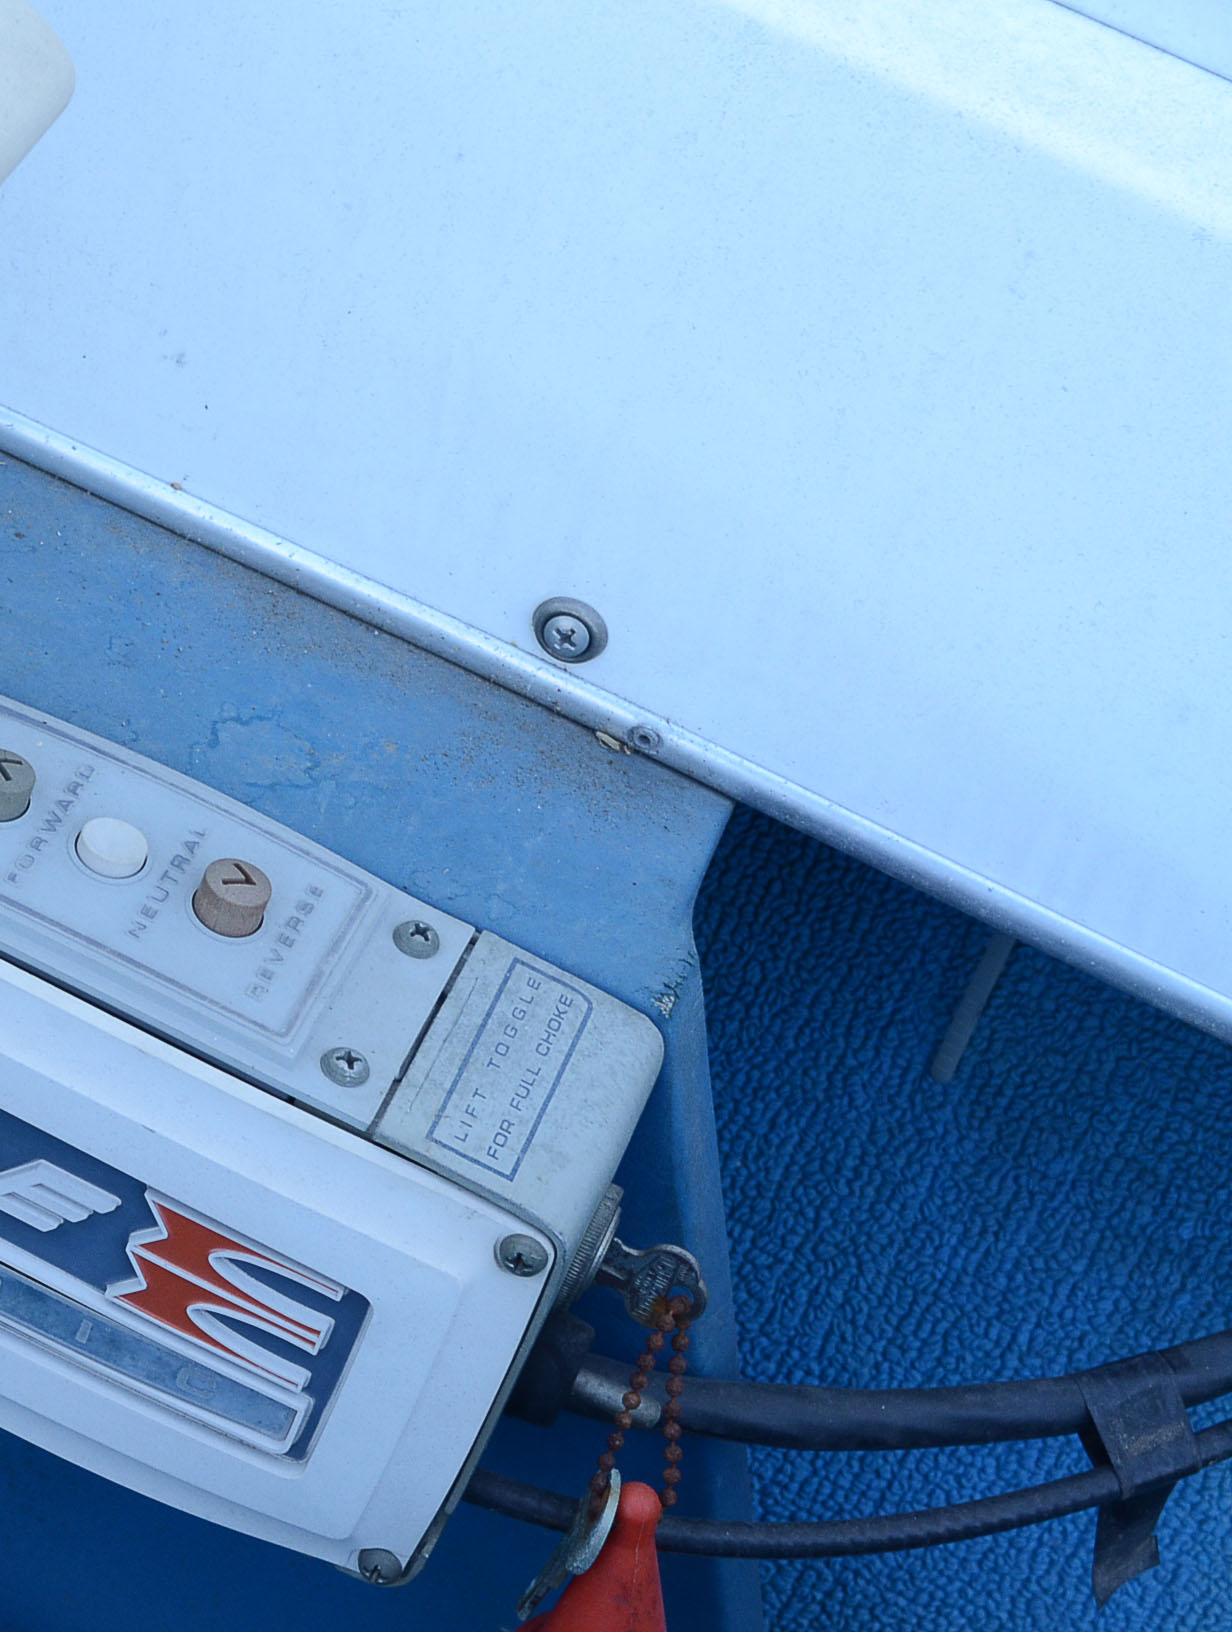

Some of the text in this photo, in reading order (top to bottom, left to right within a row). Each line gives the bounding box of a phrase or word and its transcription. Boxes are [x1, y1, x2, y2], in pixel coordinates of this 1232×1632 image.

[3, 764, 95, 885] FORWARD
[125, 829, 207, 939] NEUTRAL
[245, 883, 324, 1002] REVERSE
[453, 976, 542, 1143] LIFT TOGGLE
[486, 993, 574, 1161] FOR FULL CHOKE
